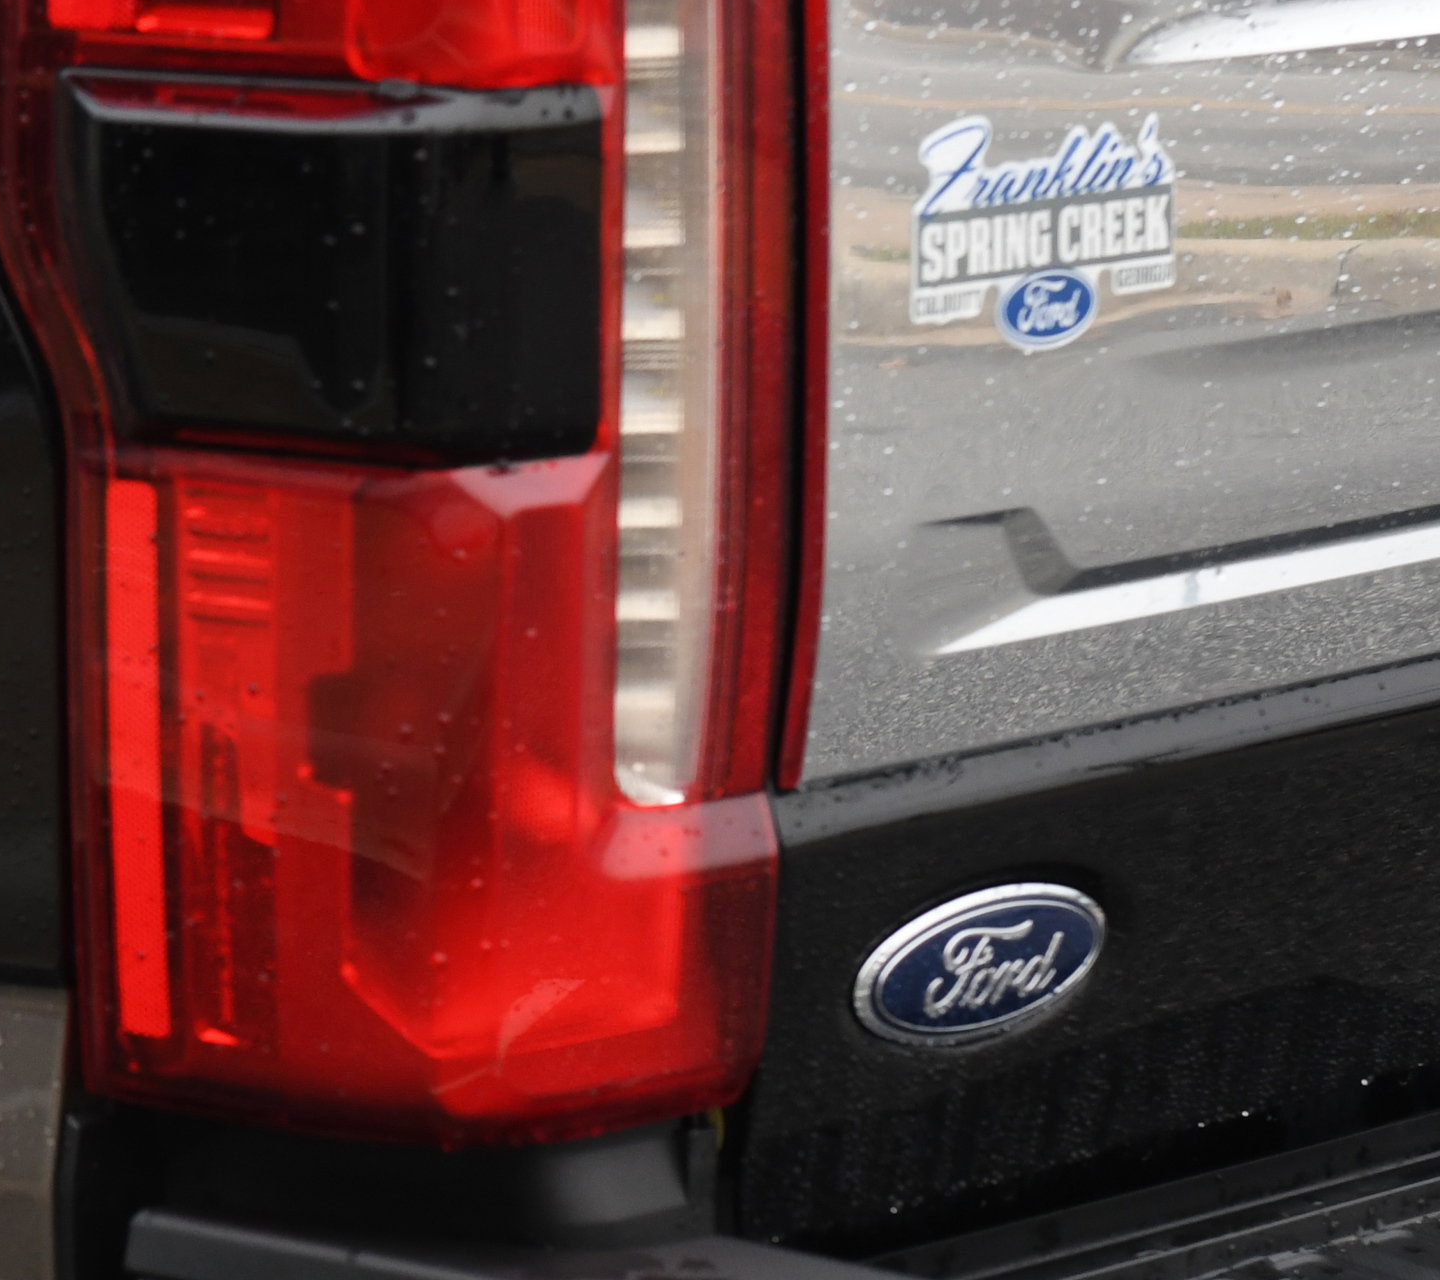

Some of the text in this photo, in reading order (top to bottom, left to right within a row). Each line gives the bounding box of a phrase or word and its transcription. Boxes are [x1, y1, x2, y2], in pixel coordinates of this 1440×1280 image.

[919, 123, 1168, 220] Franklin's
[921, 193, 1171, 283] SPRING CREEK
